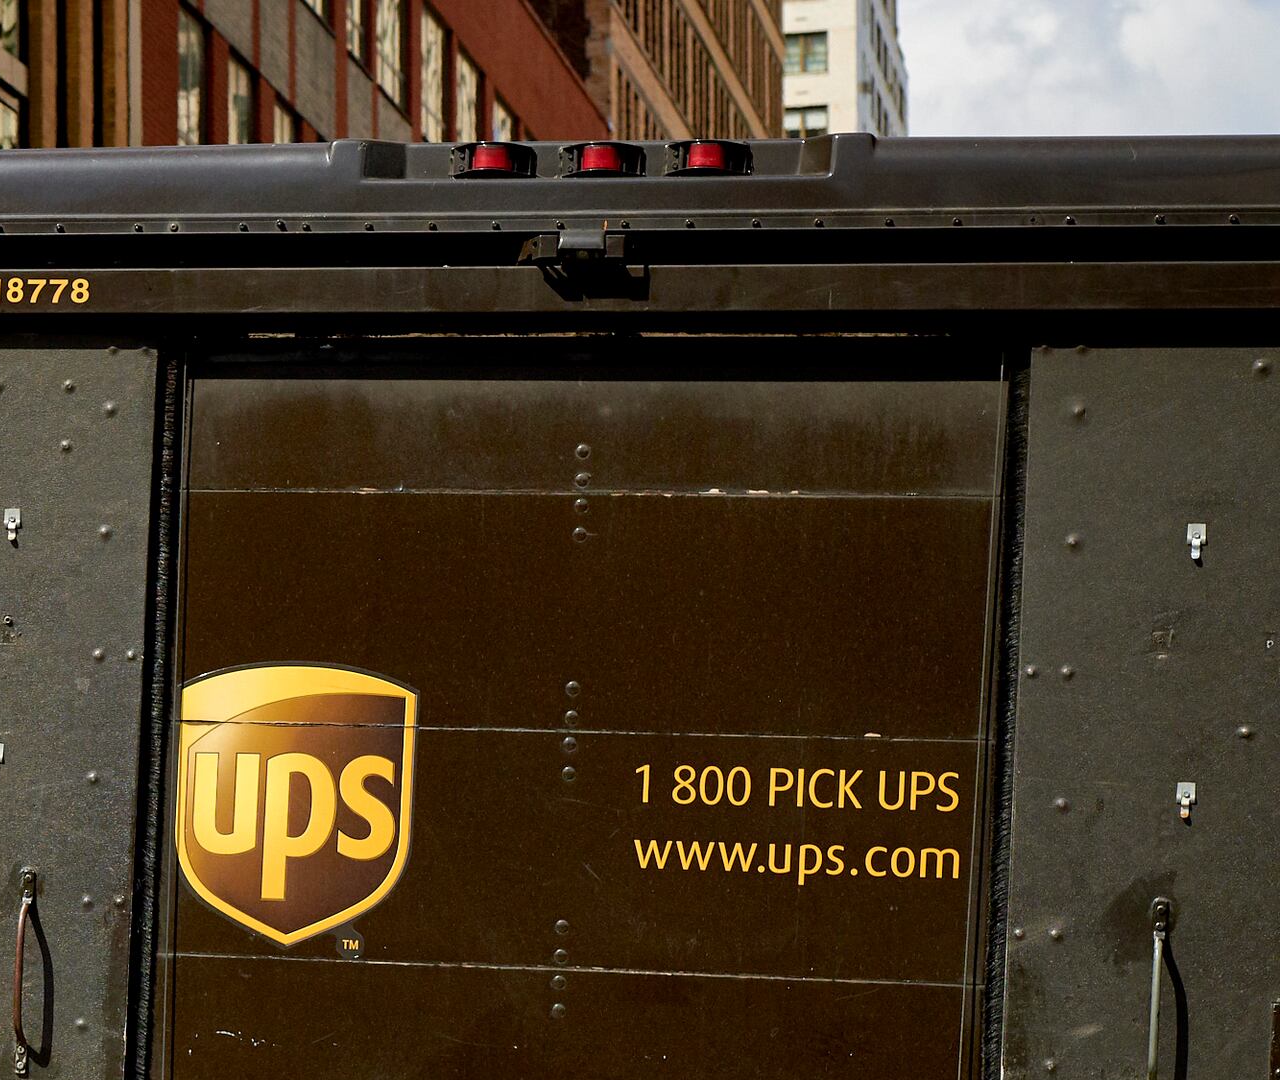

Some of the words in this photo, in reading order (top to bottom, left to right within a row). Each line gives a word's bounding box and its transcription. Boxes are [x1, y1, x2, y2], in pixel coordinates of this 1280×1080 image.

[635, 764, 650, 804] 1
[671, 765, 752, 807] 800
[768, 767, 864, 809] PICK
[878, 770, 960, 812] UPS
[192, 751, 397, 902] ups
[634, 839, 961, 886] www.ups.com
[342, 939, 360, 951] TM
